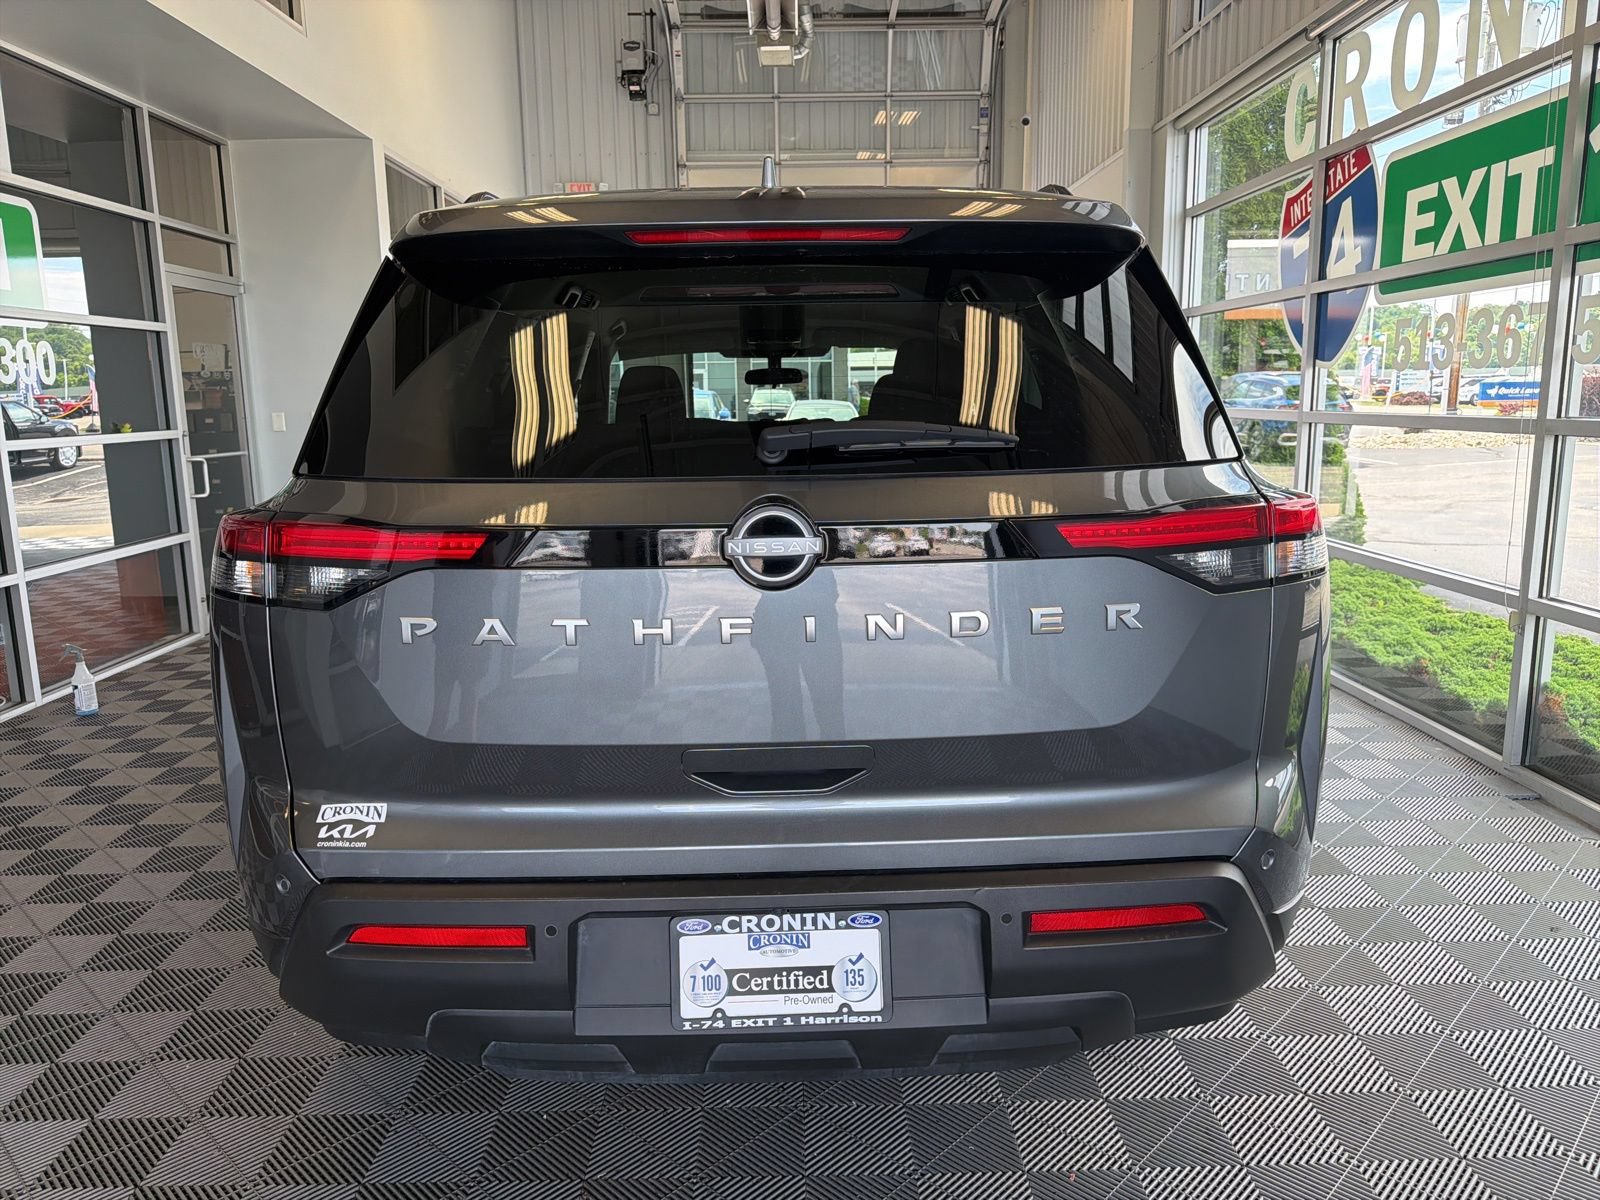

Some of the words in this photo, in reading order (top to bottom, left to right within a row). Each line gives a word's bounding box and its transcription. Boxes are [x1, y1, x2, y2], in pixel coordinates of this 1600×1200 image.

[1290, 149, 1358, 228] INTETATE
[1402, 146, 1556, 262] EXIT
[1498, 386, 1521, 395] Quick
[727, 540, 820, 554] NISSAN
[399, 602, 1145, 647] PATHFINDER
[321, 805, 385, 821] CRONIN
[316, 840, 367, 848] croninkia.com
[684, 922, 703, 931] Ford
[721, 912, 836, 933] CRONIN
[855, 914, 874, 924] Ford
[749, 932, 809, 949] CRONIN
[690, 975, 697, 993] 7
[701, 974, 721, 992] 100
[731, 970, 829, 992] Certified
[844, 968, 865, 987] 135
[784, 995, 834, 1006] Pre-Owned
[683, 1019, 725, 1030] I-74
[731, 1018, 777, 1028] EXIT
[783, 1017, 794, 1026] 1
[800, 1014, 882, 1025] Harrison
